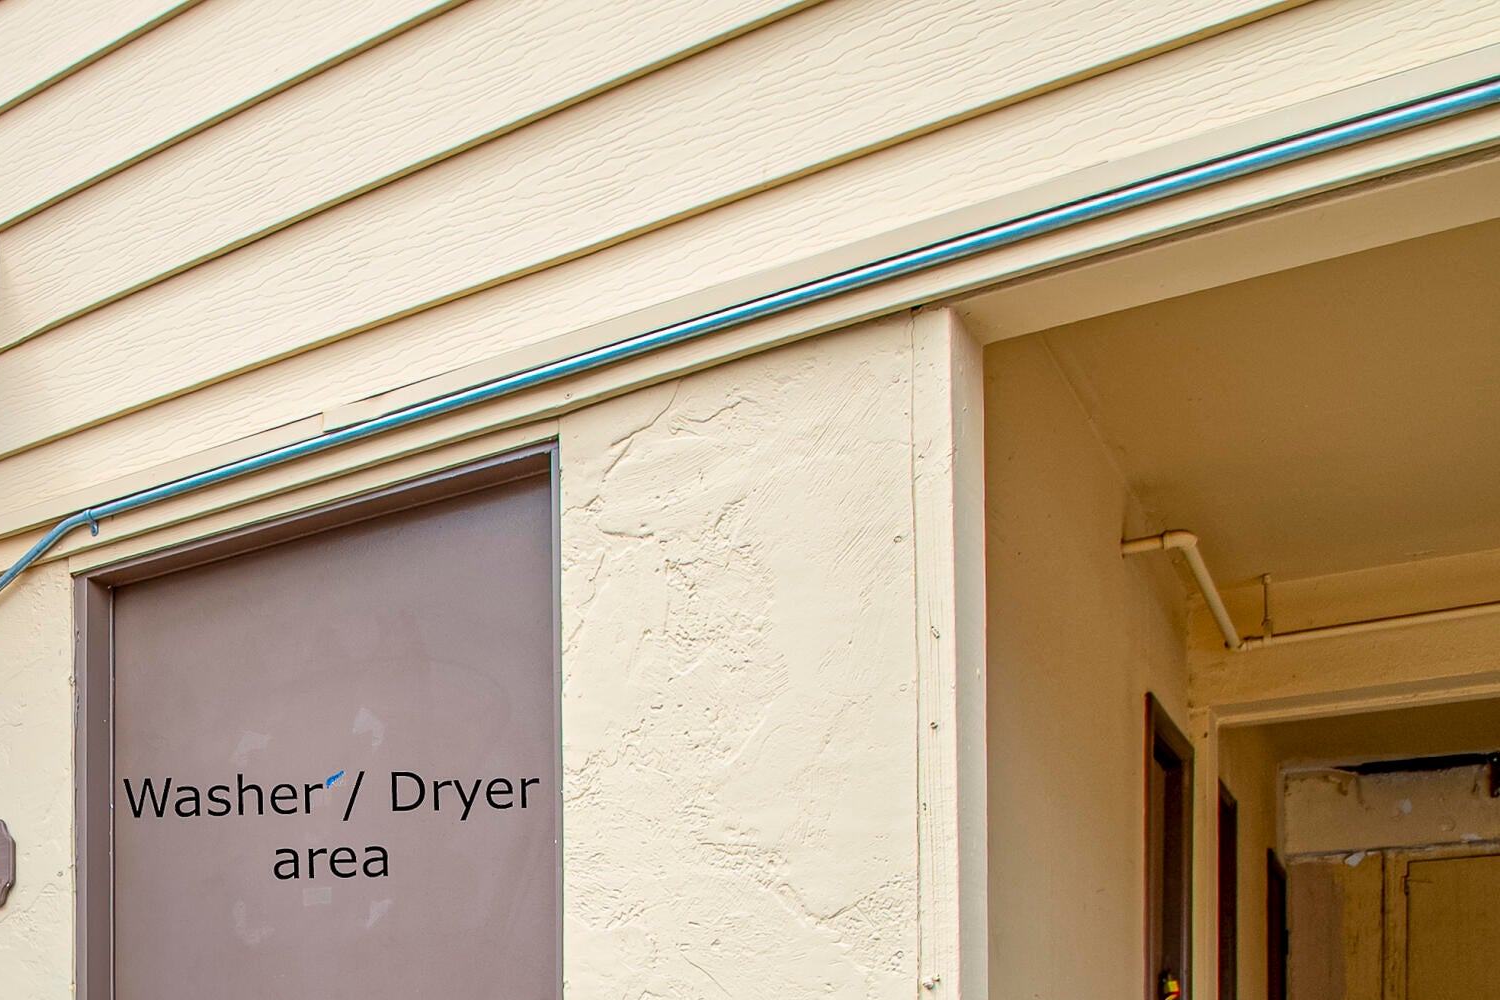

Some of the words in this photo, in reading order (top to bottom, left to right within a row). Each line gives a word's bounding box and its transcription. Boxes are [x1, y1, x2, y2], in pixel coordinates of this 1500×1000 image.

[122, 773, 324, 819] Washer
[342, 770, 365, 822] /
[390, 771, 540, 822] Dryer
[272, 845, 389, 880] area
